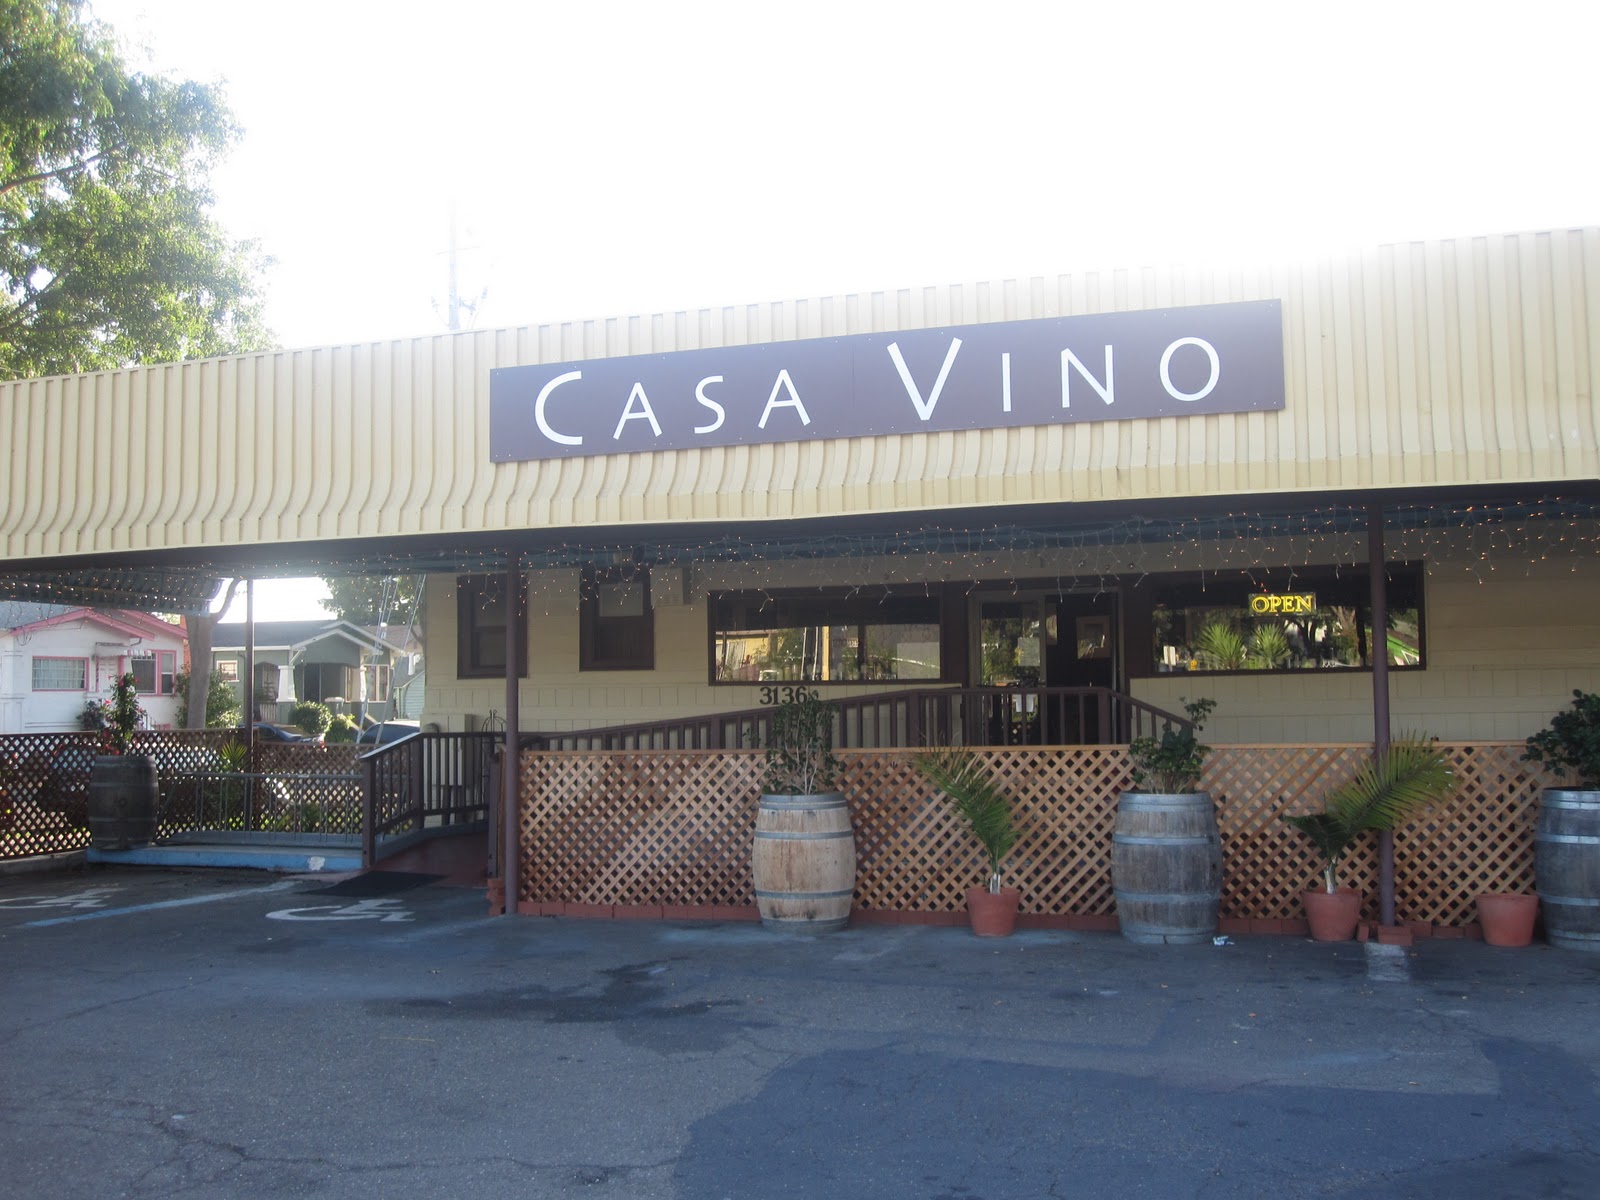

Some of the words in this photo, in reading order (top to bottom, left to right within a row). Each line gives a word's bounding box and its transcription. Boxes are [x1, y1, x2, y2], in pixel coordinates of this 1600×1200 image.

[534, 368, 812, 446] CASA
[886, 336, 1221, 421] VINO
[1251, 595, 1313, 613] OPEN
[759, 686, 808, 706] 3136
